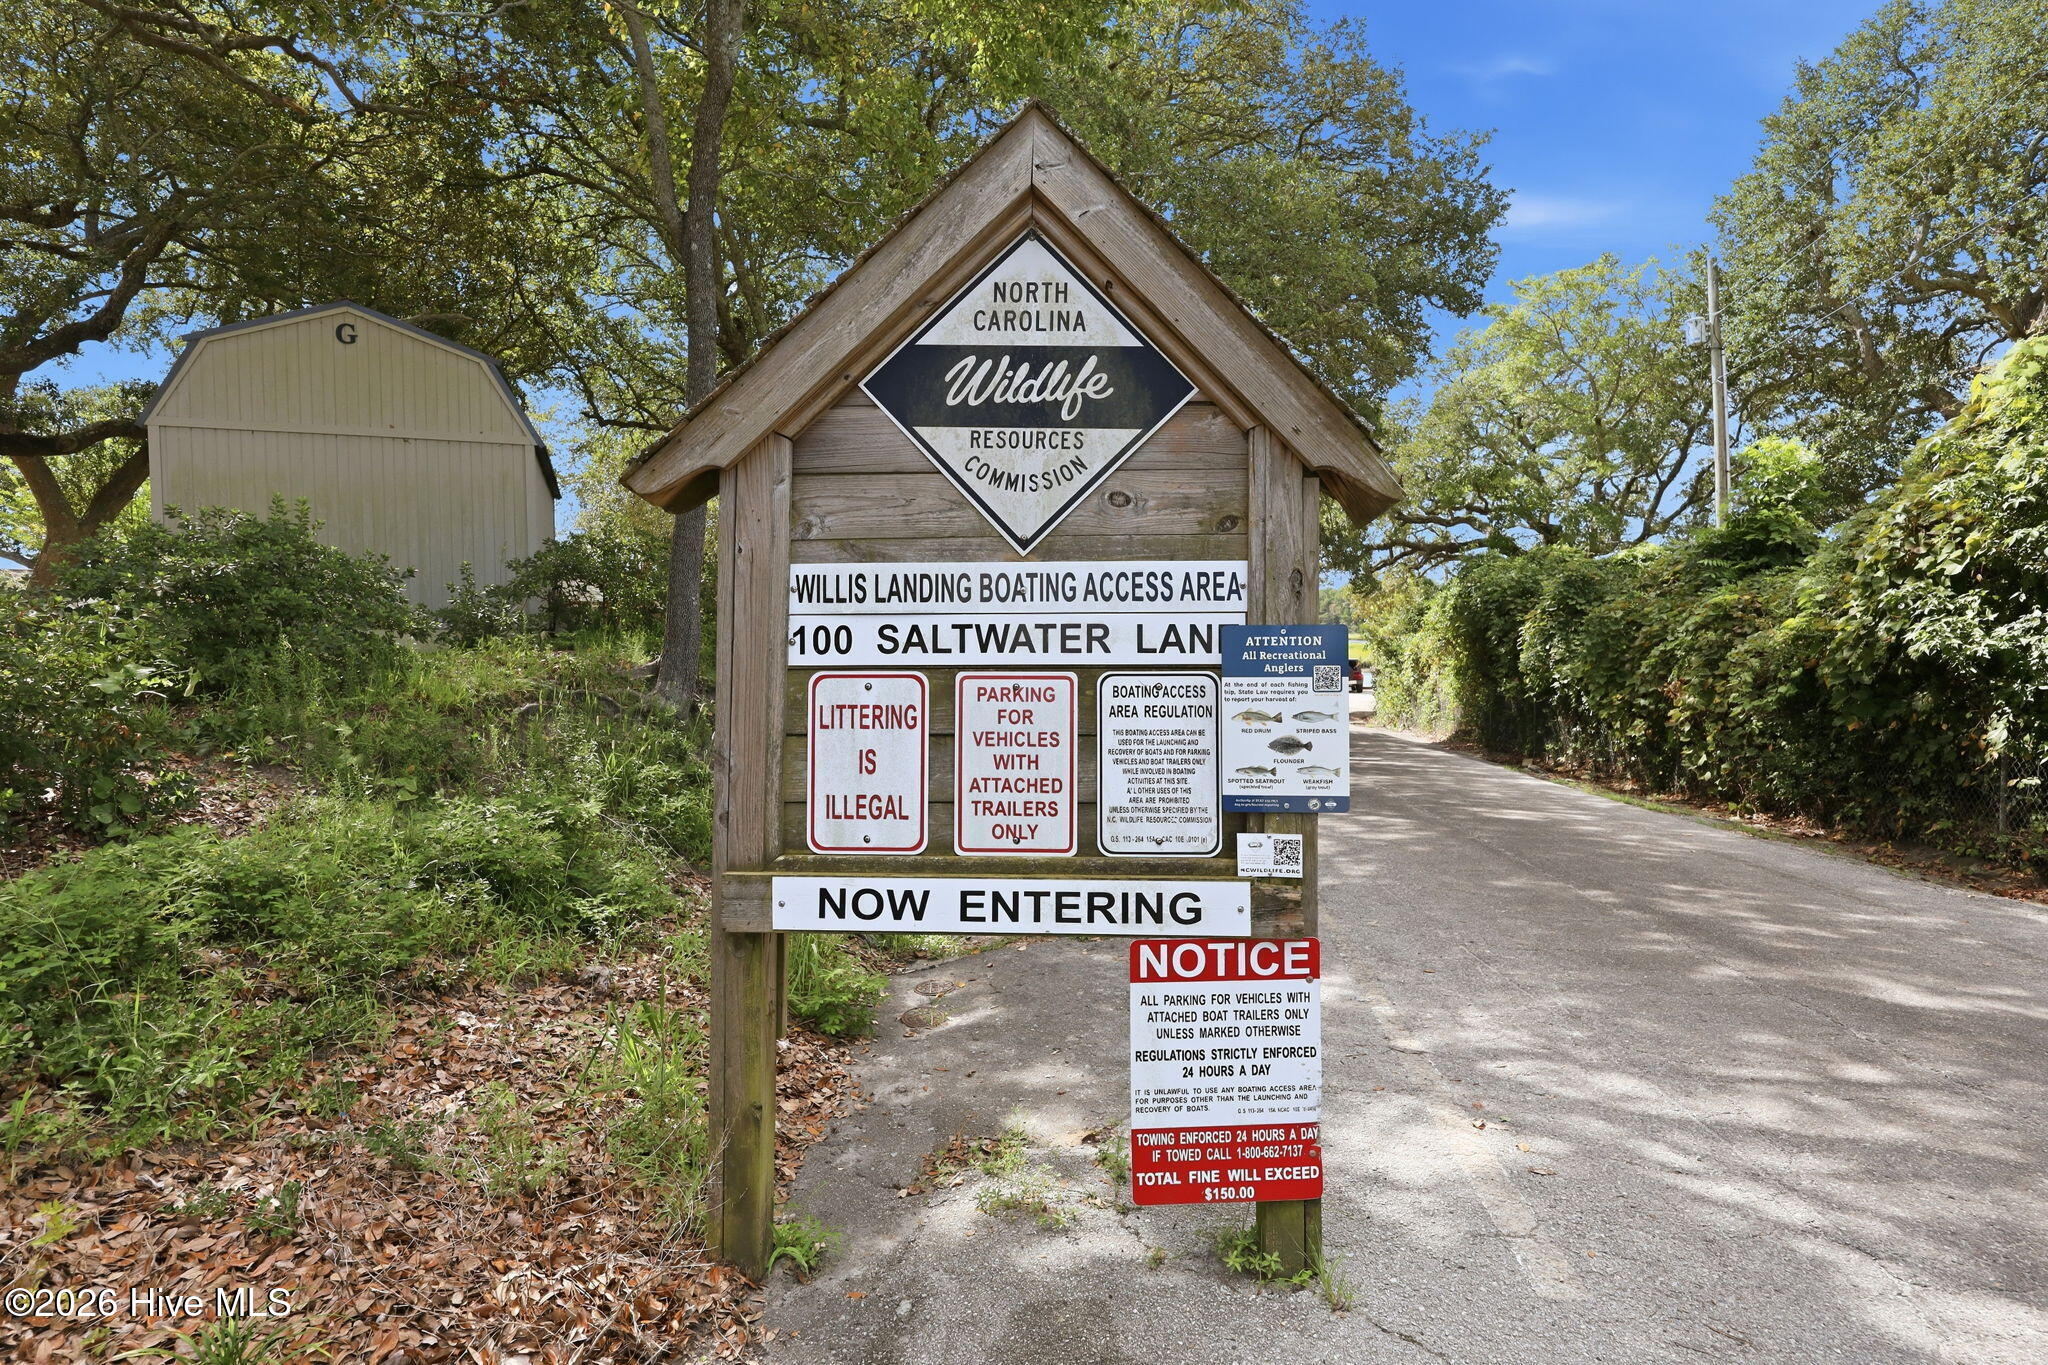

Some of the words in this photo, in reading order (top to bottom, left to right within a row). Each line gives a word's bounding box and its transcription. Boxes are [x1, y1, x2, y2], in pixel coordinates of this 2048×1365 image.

[993, 282, 1068, 303] NORTH
[974, 310, 1086, 331] CAROLINA
[336, 323, 358, 344] G
[945, 354, 1113, 421] Wildlife
[971, 430, 1084, 450] RESOURCES
[964, 456, 1088, 492] COMMISSION
[796, 574, 867, 603] WILLIS
[875, 573, 972, 602] LANDING
[980, 572, 1077, 602] BOATING
[1083, 572, 1173, 602] ACCESS
[1180, 572, 1243, 601] AREA
[792, 625, 852, 655] 100
[877, 624, 1112, 654] SALTWATER
[1137, 624, 1239, 653] LAN
[1246, 637, 1322, 646] ATTENTION
[1243, 652, 1256, 660] All
[1260, 651, 1326, 660] Recreational
[1264, 664, 1303, 673] Anglers
[977, 687, 1055, 702] PARKING
[1113, 686, 1159, 698] BOATING
[1163, 686, 1206, 698] ACCESS
[820, 705, 917, 730] LITTERING
[998, 709, 1033, 725] FOR
[1109, 705, 1138, 718] AREA
[1145, 705, 1212, 718] REGULATION
[973, 732, 1060, 747] VEHICLES
[859, 749, 876, 775] IS
[994, 754, 1039, 770] WITH
[969, 778, 1062, 793] ATTACHED
[826, 795, 909, 820] ILLEGAL
[972, 801, 1058, 817] TRAILERS
[992, 824, 1038, 840] ONLY
[819, 888, 930, 921] NOW
[960, 891, 1202, 925] ENTERING
[1139, 941, 1310, 979] NOTICE
[1141, 996, 1158, 1006] ALL
[1164, 994, 1206, 1005] PARKING
[1211, 993, 1231, 1004] FOR
[1236, 993, 1282, 1004] VEHICLES
[1287, 992, 1311, 1003] WITH
[1147, 1011, 1198, 1023] ATTACHED
[1203, 1011, 1228, 1021] BOAT
[1233, 1009, 1280, 1021] TRAILERS
[1285, 1009, 1309, 1020] ONLY
[1157, 1028, 1194, 1039] UNLESS
[1199, 1027, 1240, 1039] MARKED
[1246, 1025, 1301, 1037] OTHERWISE
[1136, 1049, 1205, 1062] REGULATIONS
[1211, 1048, 1257, 1060] STRICTLY
[1263, 1047, 1317, 1059] ENFORCED
[1183, 1067, 1194, 1078] 24
[1199, 1065, 1234, 1077] HOURS
[1239, 1065, 1247, 1076] A
[1251, 1064, 1271, 1076] DAY
[1137, 1134, 1174, 1146] TOWING
[1180, 1132, 1232, 1144] ENFORCED
[1236, 1131, 1247, 1142] 24
[1252, 1130, 1285, 1142] HOURS
[1290, 1129, 1296, 1140] A
[1301, 1128, 1319, 1140] DAY
[1152, 1151, 1161, 1162] IF
[1166, 1149, 1201, 1161] TOWED
[1207, 1148, 1231, 1160] CALL
[1237, 1145, 1303, 1159] 1-800-662-7137
[1137, 1172, 1181, 1185] TOTAL
[1189, 1170, 1220, 1184] FINE
[1228, 1169, 1261, 1182] WILL
[1265, 1166, 1320, 1181] EXCEED
[1204, 1187, 1254, 1201] $150.00
